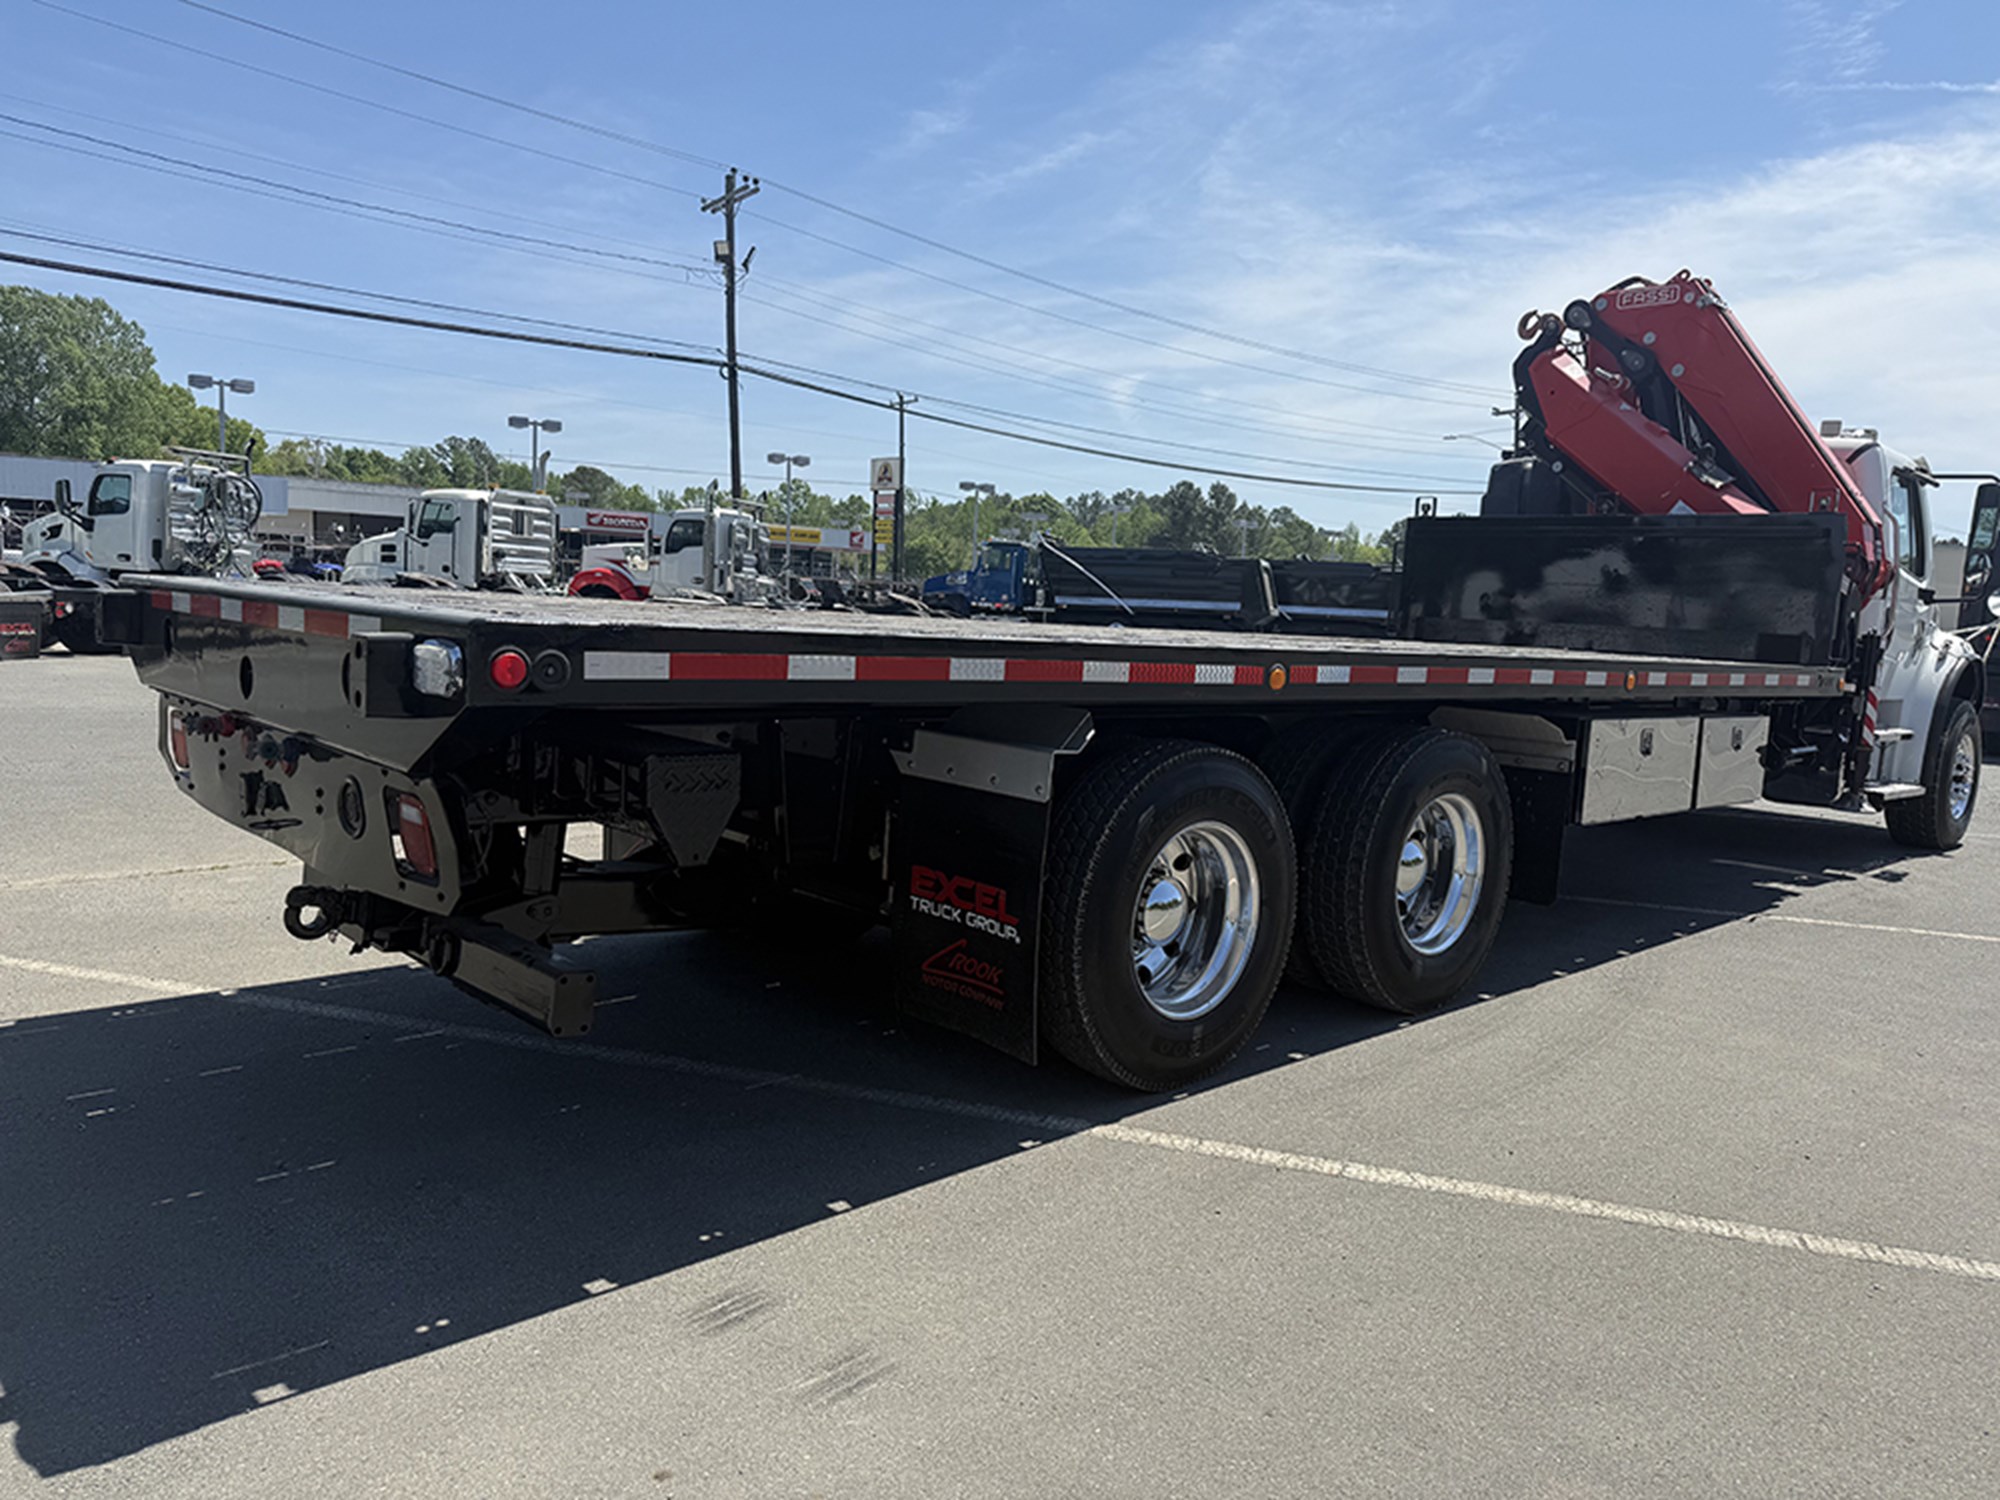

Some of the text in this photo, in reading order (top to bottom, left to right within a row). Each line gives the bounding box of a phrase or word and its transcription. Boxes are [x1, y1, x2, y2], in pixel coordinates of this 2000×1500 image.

[1622, 287, 1675, 305] FASSI
[910, 865, 1020, 925] EXCEL
[910, 896, 962, 923] TRUCK
